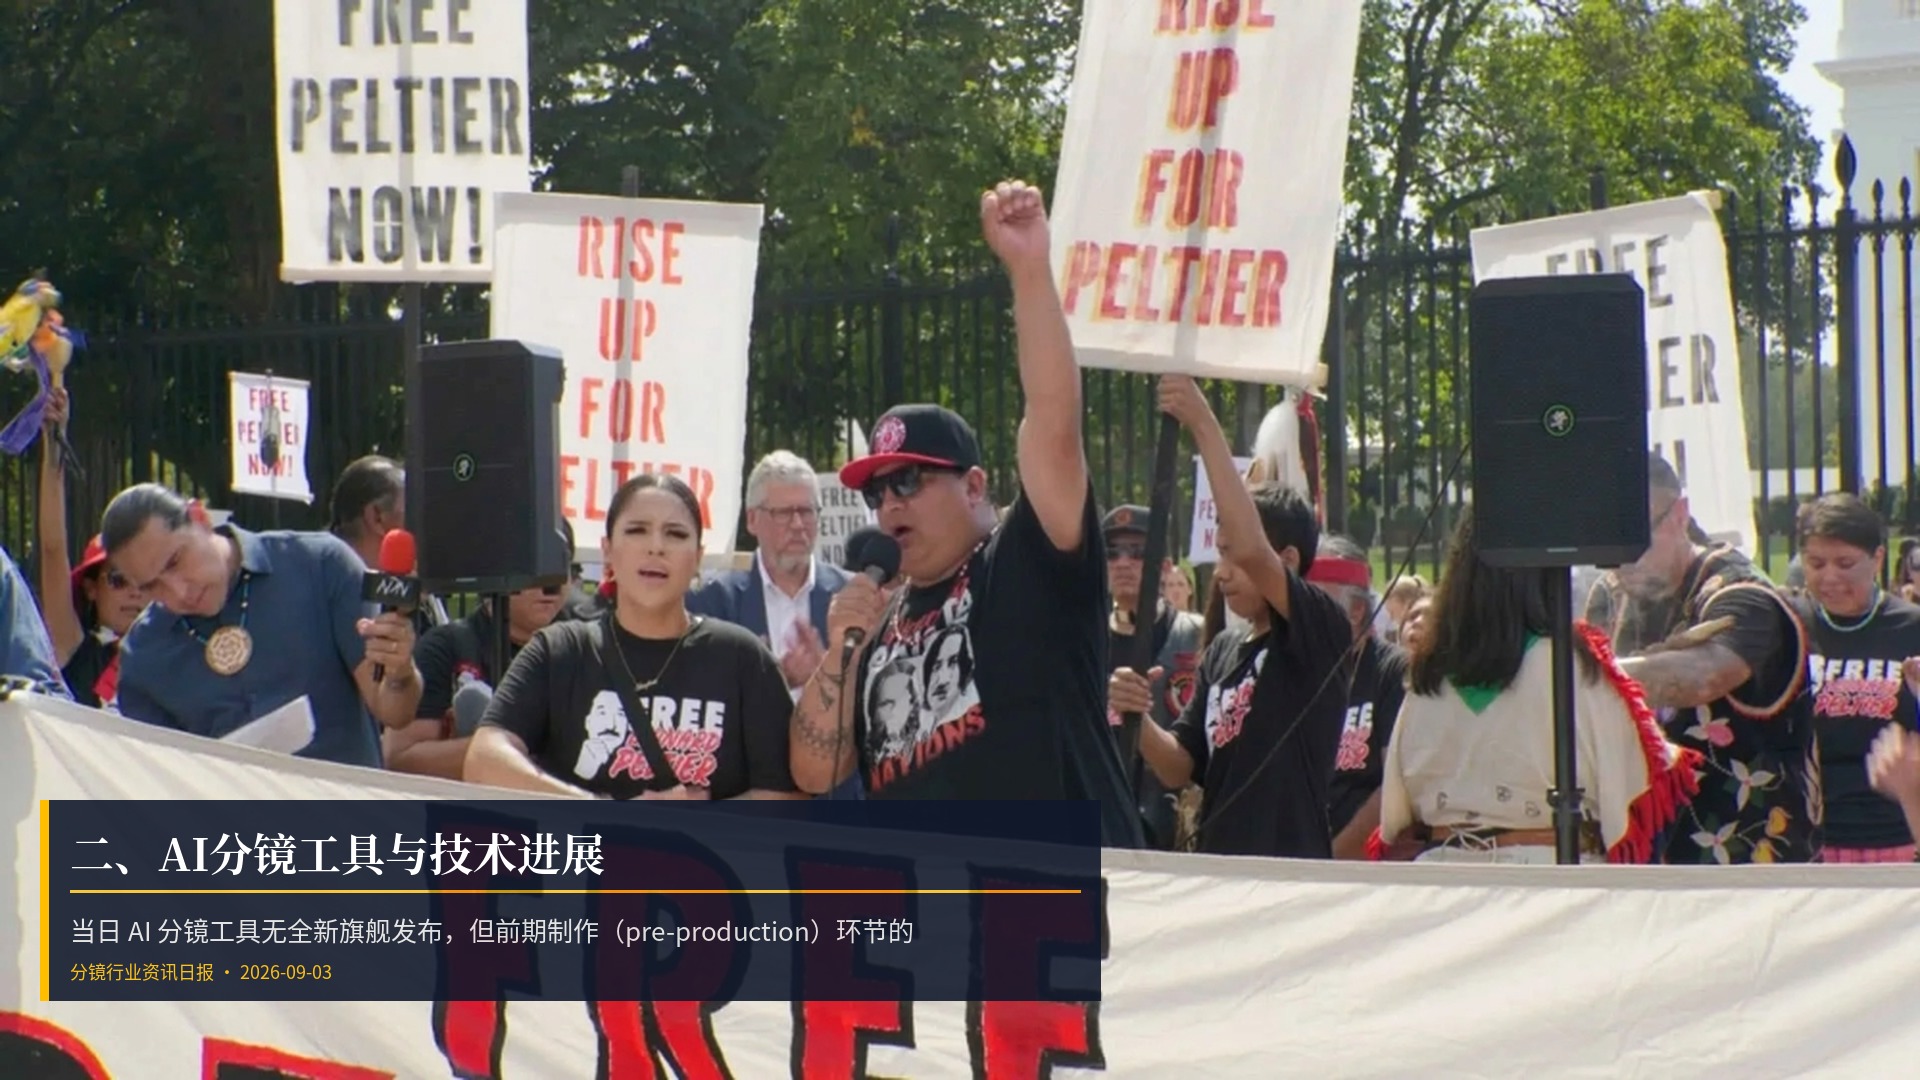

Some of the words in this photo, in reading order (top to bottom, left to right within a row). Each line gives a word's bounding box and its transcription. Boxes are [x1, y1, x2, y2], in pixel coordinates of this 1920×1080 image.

[290, 77, 524, 154] PELTIER
[1166, 47, 1240, 133] UP
[328, 186, 482, 263] NOW!
[1135, 147, 1244, 232] FOR
[577, 216, 686, 285] RISE
[1061, 240, 1289, 328] PELTIER
[598, 297, 657, 362] UP
[579, 376, 666, 444] FOR
[1825, 659, 1903, 682] FREE
